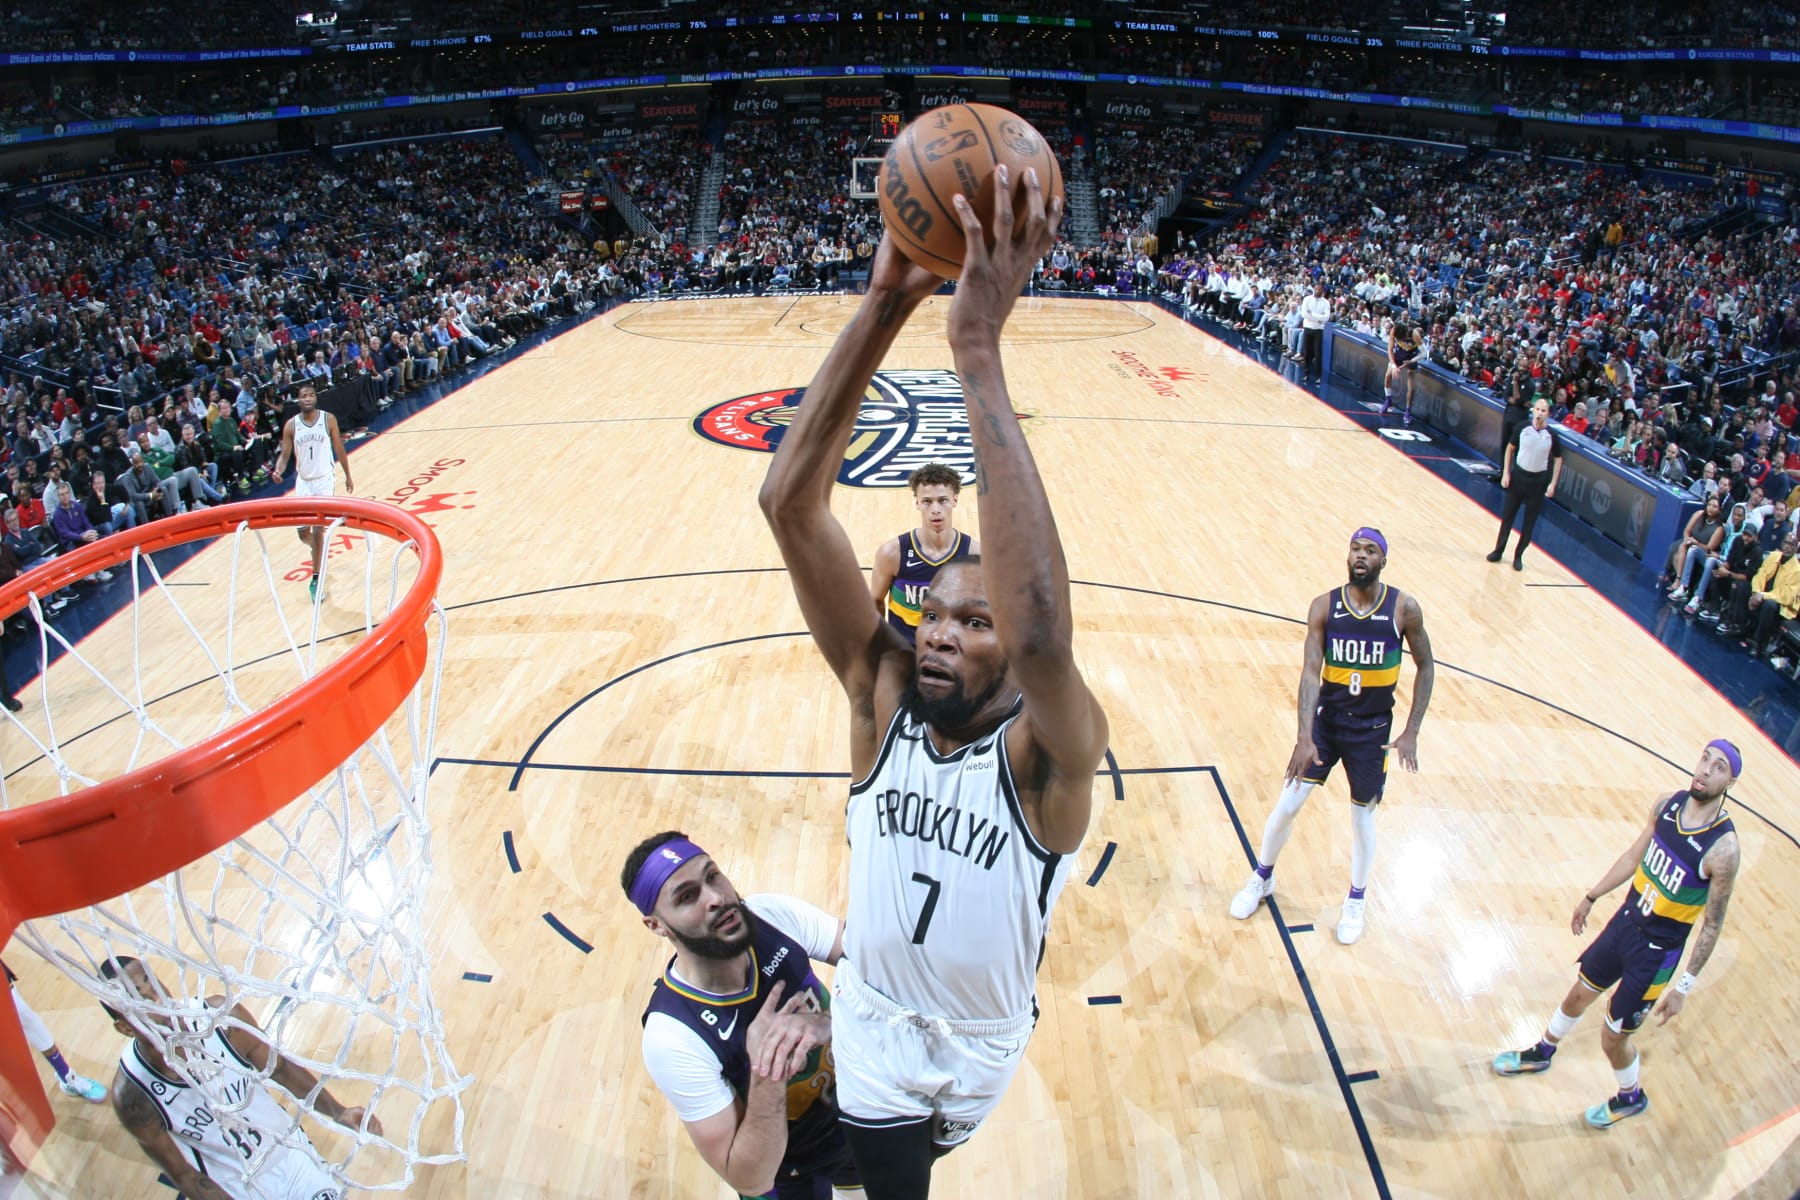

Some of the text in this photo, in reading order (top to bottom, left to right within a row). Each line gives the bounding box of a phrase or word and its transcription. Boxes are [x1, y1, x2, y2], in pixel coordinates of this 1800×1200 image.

[612, 21, 708, 32] THREE POINTERS 75%
[346, 43, 368, 52] TEAM
[369, 42, 396, 50] STATS:
[411, 39, 431, 47] FREE
[433, 37, 468, 46] THROWS
[474, 35, 492, 43] 67%
[521, 31, 543, 39] FIELD
[1125, 22, 1489, 55] TEAM STATS: FREE THROWS 100% FIELD GOALS 33% THREE POINTERS 75%
[10, 52, 115, 64] Official Bank of the New Orleans Pelicans
[681, 68, 812, 82] Official Bank of the New Orleans Pelicans
[964, 66, 1096, 81] Official Bank of the New Orleans Pelicans
[734, 98, 779, 110] Let's Go
[826, 96, 883, 108] SEATGEEK
[921, 95, 967, 106] Let's Go
[642, 104, 697, 118] SEATGEEK
[1106, 103, 1151, 116] Let's Go
[541, 111, 584, 125] Let's Go
[881, 114, 900, 123] 2:08
[603, 129, 620, 137] Let's
[714, 395, 776, 441] PELICANS
[309, 446, 313, 460] 1
[1332, 638, 1385, 665] NOLA
[1349, 672, 1361, 696] 8
[1643, 838, 1686, 895] NOLA
[1637, 882, 1659, 917] 15
[911, 872, 941, 945] 7
[762, 946, 789, 977] ibotta
[700, 1010, 719, 1026] 6
